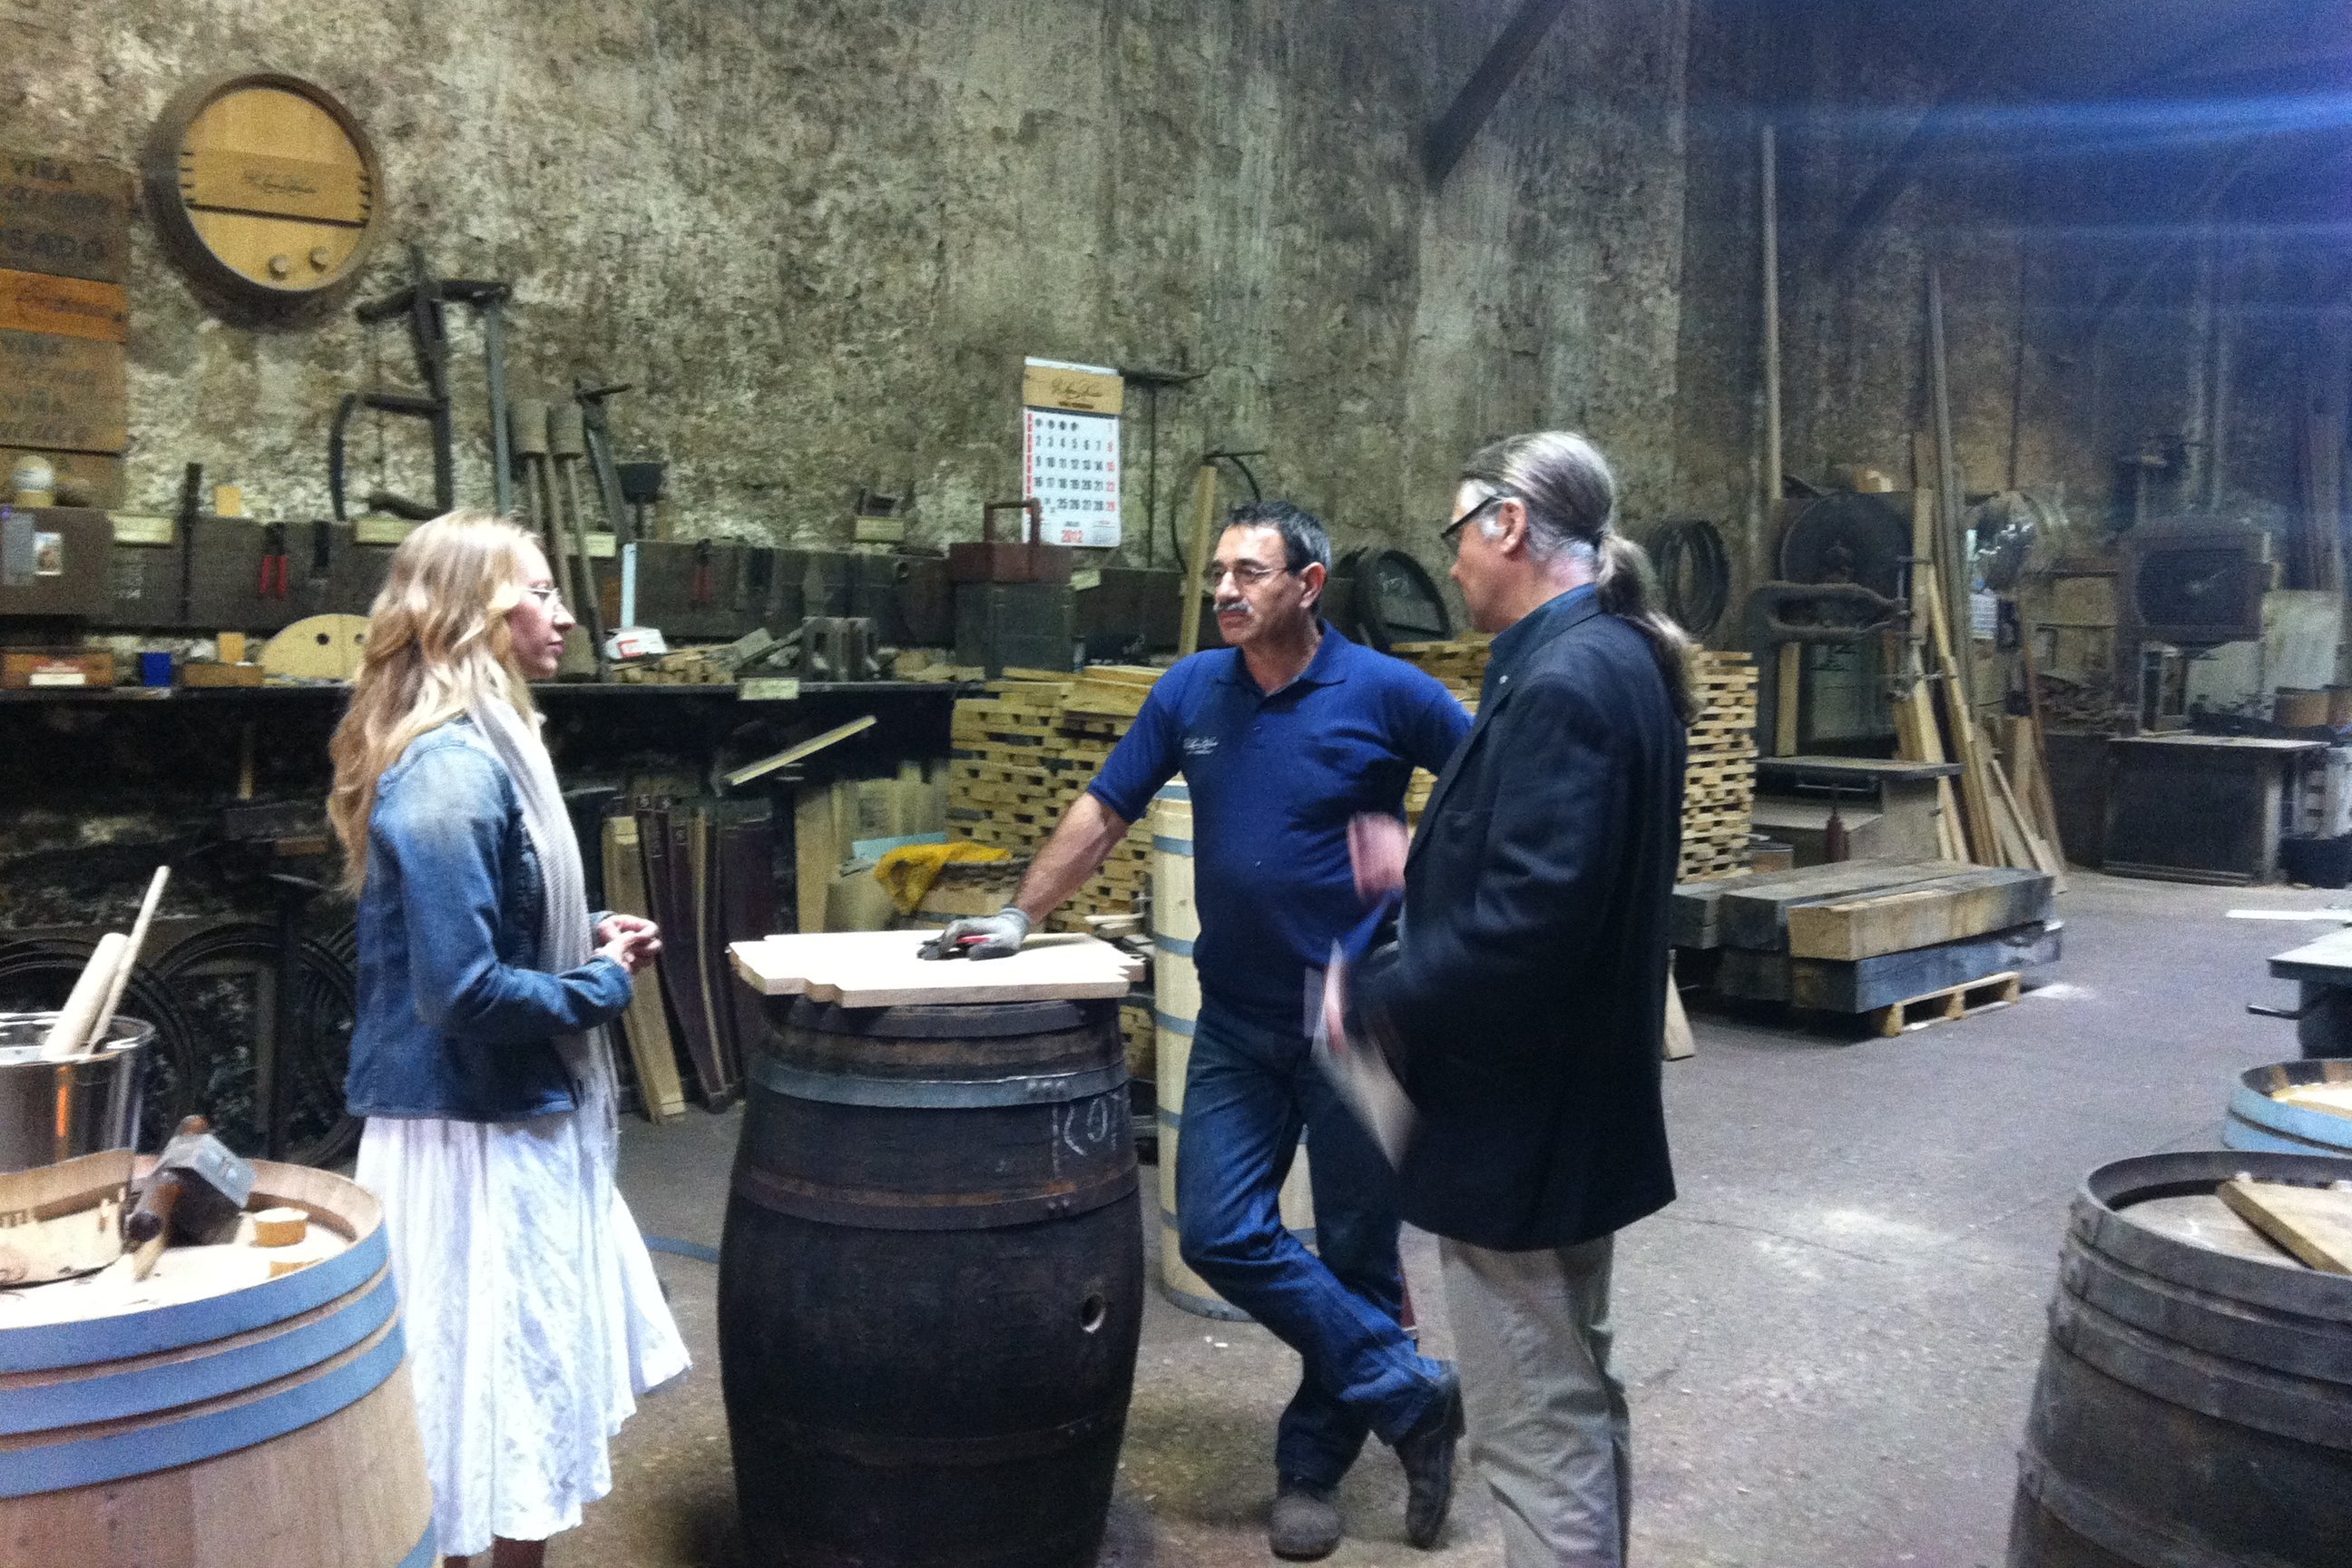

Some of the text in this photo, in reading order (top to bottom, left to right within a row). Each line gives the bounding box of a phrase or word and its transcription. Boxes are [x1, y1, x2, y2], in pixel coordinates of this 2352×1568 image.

[1035, 435, 1041, 446] 2
[1060, 437, 1065, 448] 4
[1072, 438, 1078, 449] 5
[1046, 456, 1055, 468] 10
[1071, 458, 1079, 470] 12
[1094, 461, 1102, 472] 14
